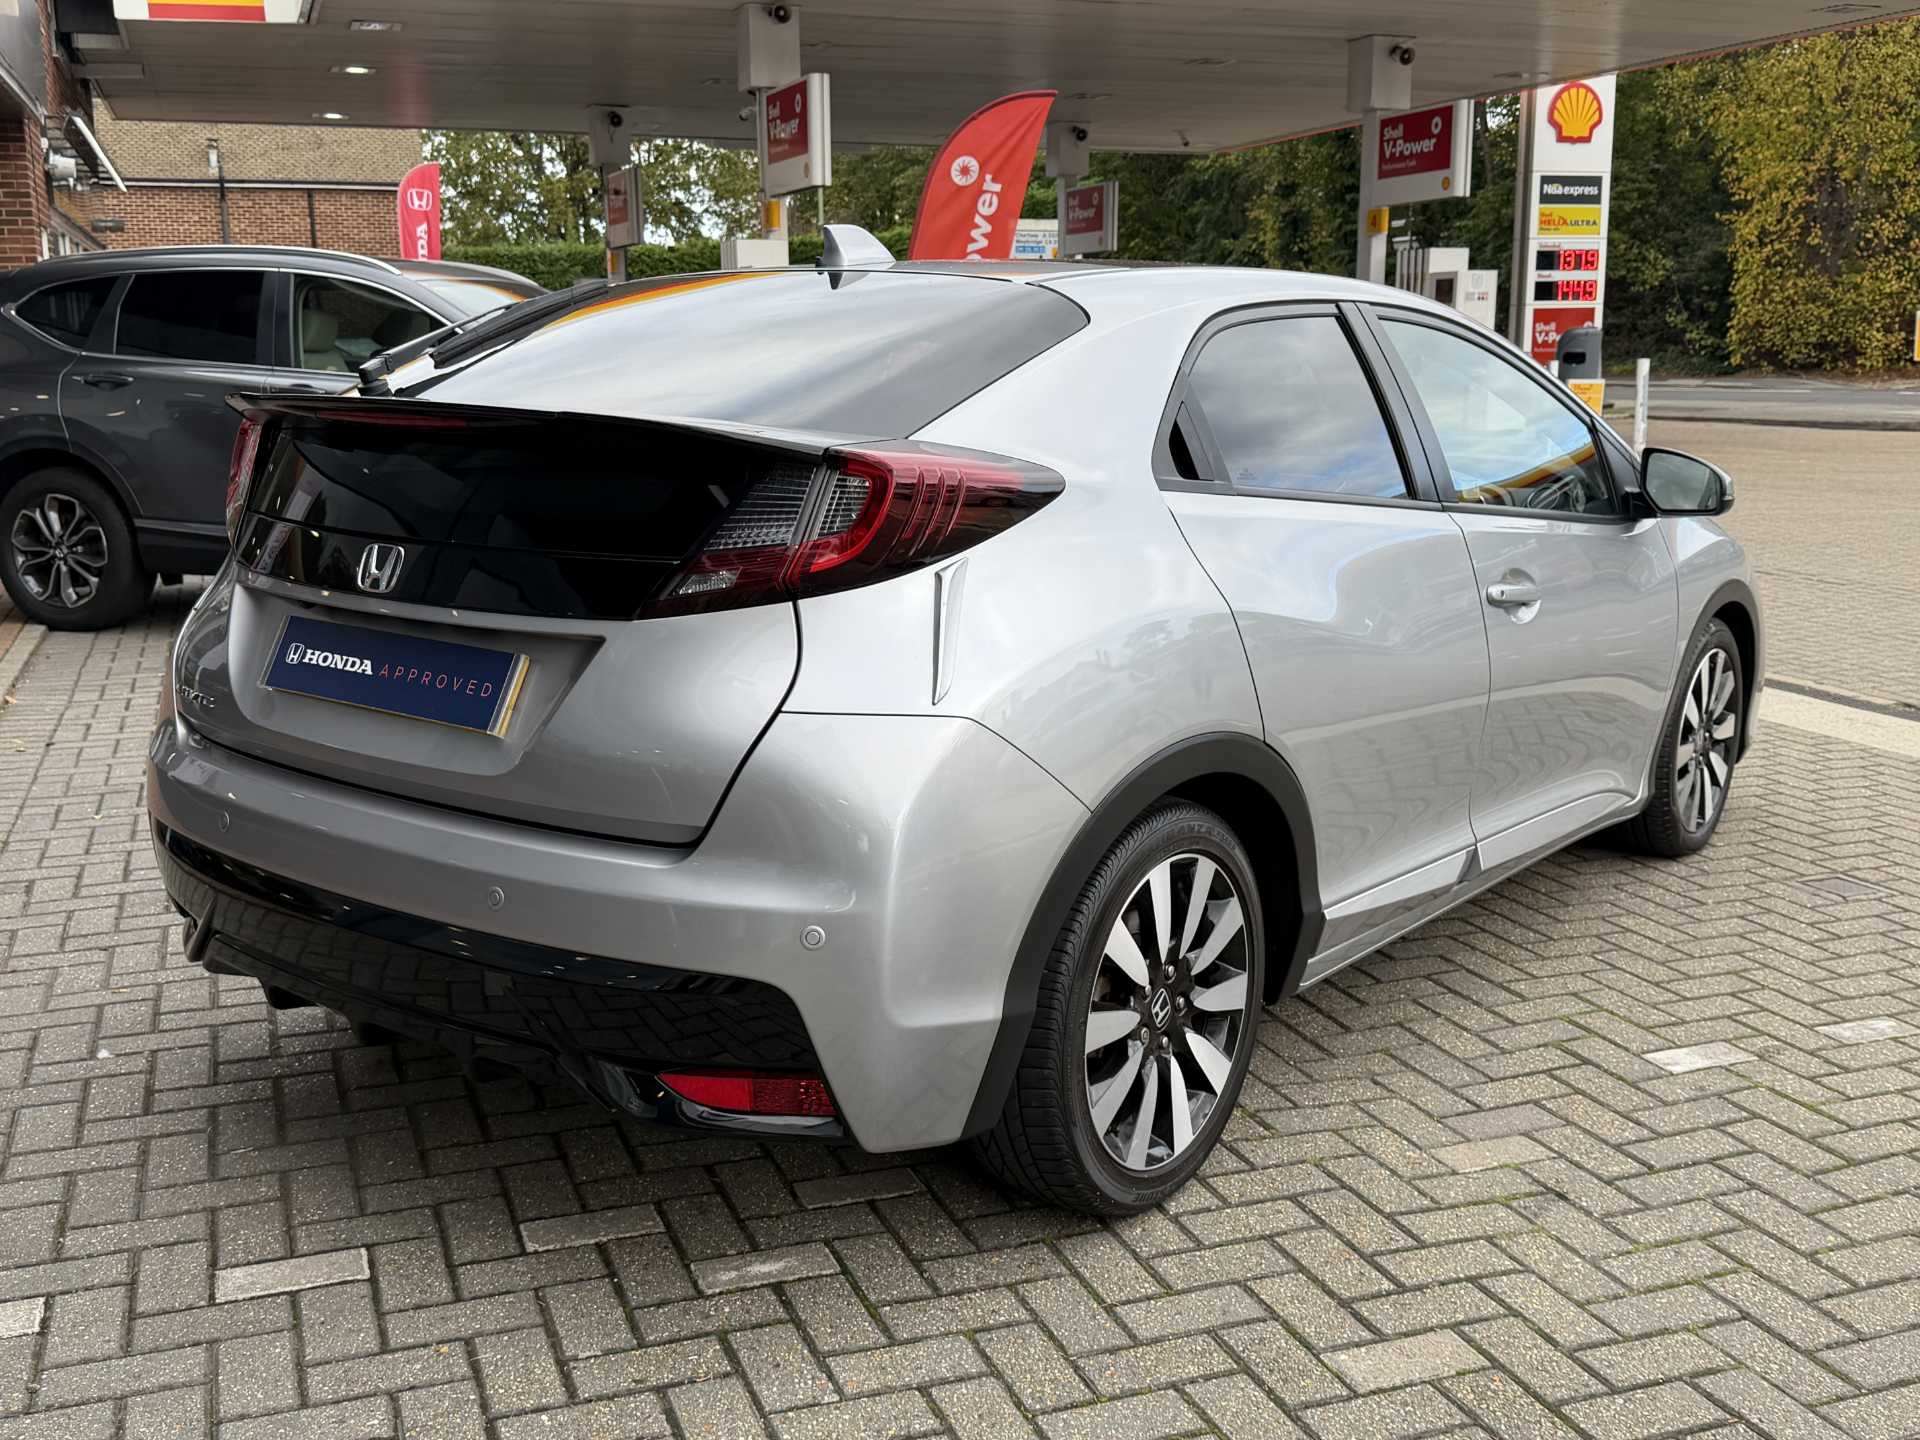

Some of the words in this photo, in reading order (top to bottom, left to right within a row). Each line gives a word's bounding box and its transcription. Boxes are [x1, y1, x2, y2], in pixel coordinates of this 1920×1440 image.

[1383, 123, 1404, 140] Shell
[1383, 137, 1437, 159] V-Power
[1563, 185, 1599, 197] express
[1569, 219, 1599, 227] ULTRA
[1535, 321, 1556, 332] Shell
[302, 648, 373, 675] HONDA
[378, 663, 494, 698] APPROVED
